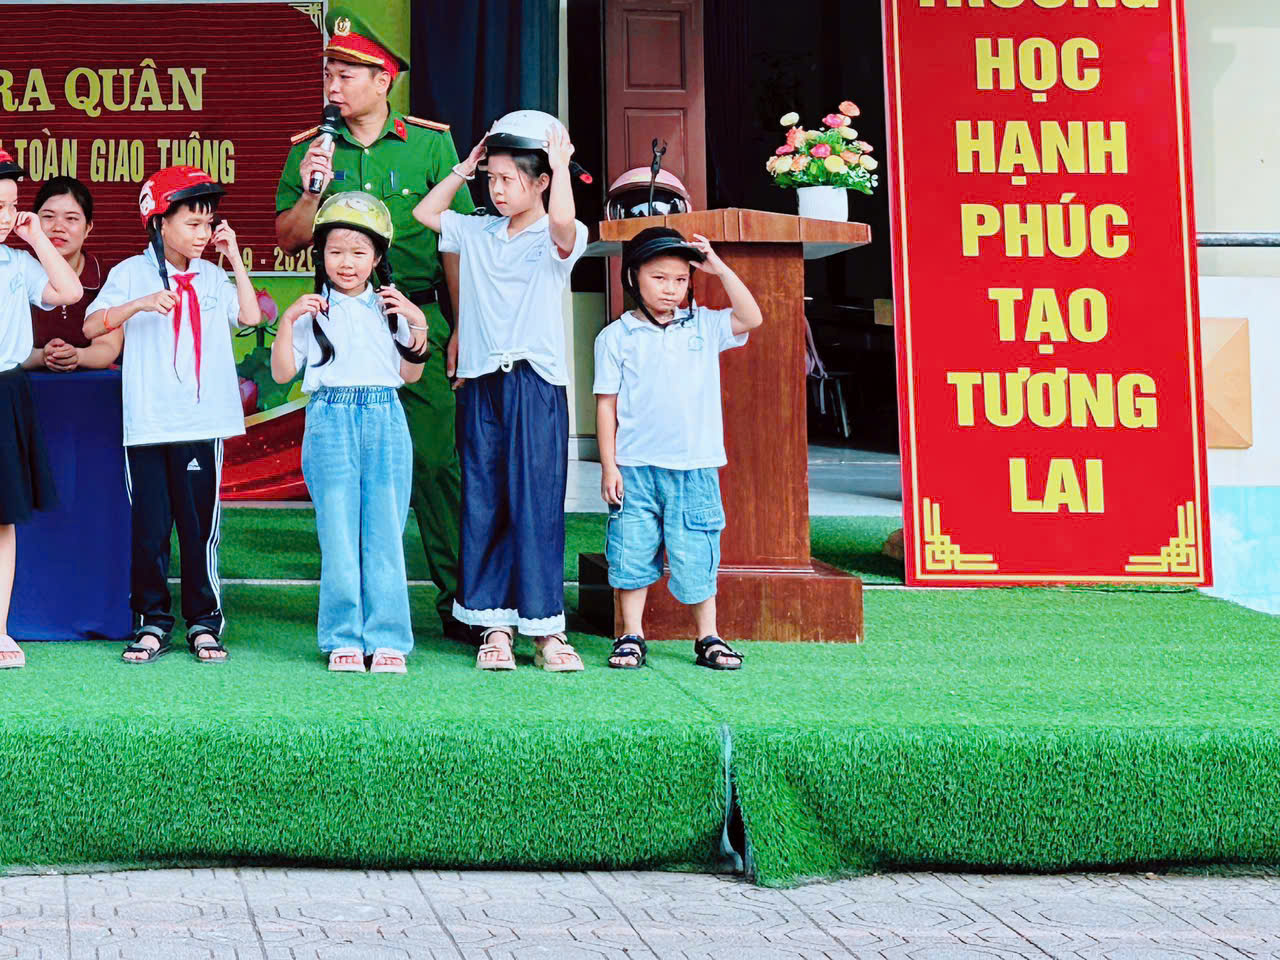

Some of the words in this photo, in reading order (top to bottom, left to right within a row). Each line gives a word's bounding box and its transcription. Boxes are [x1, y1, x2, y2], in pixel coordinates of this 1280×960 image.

[64, 58, 207, 118] QUÂN
[975, 37, 1101, 103] HỌC
[14, 128, 78, 183] TOÀN
[90, 138, 145, 184] GIAO
[157, 130, 235, 185] THÔNG
[955, 120, 1129, 186] HẠNH
[960, 192, 1130, 259] PHÚC
[988, 287, 1109, 355] TẠO
[946, 366, 1159, 429] TƯƠNG
[1009, 457, 1105, 514] LAI
